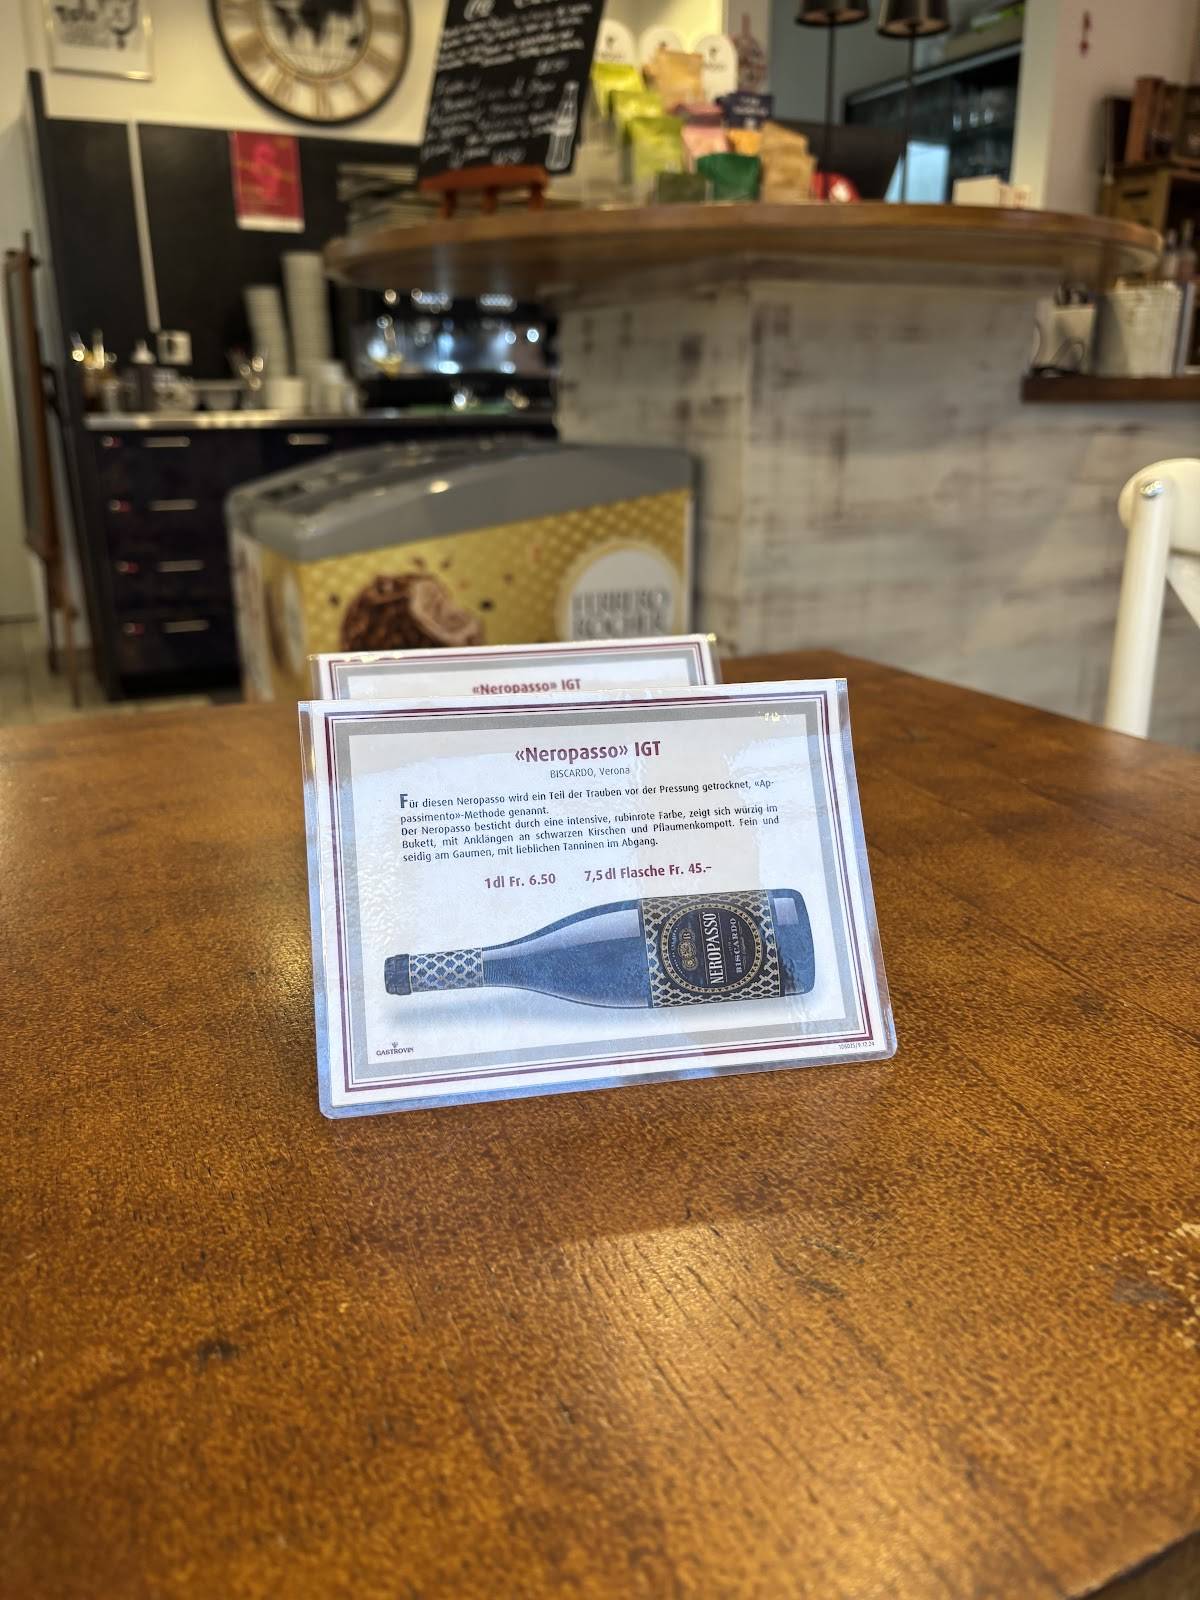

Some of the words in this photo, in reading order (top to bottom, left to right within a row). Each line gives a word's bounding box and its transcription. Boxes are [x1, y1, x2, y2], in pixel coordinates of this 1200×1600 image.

[561, 678, 582, 691] IGT
[514, 745, 628, 764] «Neropasso»
[634, 740, 661, 757] IGT
[550, 767, 596, 779] BISCARDO,
[599, 766, 630, 776] Verona
[399, 793, 419, 809] Für
[422, 797, 454, 808] diesen
[456, 795, 505, 807] Neropasso
[508, 792, 529, 803] wird
[532, 792, 546, 801] ein
[549, 790, 565, 800] Teil
[568, 789, 582, 799] der
[586, 787, 622, 798] Trauben
[625, 787, 639, 796] vor
[642, 785, 656, 795] der
[659, 783, 699, 796] Pressung
[702, 779, 752, 793] getrocknet,
[401, 826, 417, 836] Der
[421, 823, 471, 836] Neropasso
[474, 820, 511, 832] besticht
[515, 818, 540, 829] durch
[544, 817, 564, 827] eine
[567, 814, 613, 826] intensive,
[614, 812, 655, 823] rubinrote
[658, 809, 685, 820] Farbe,
[689, 808, 710, 820] zeigt
[714, 806, 731, 817] sich
[734, 804, 763, 817] würzig
[766, 804, 778, 813] im
[508, 806, 549, 819] genannt.
[402, 838, 437, 850] Bukett,
[442, 836, 458, 846] mit
[463, 833, 514, 846] Anklängen
[518, 833, 530, 842] an
[535, 830, 583, 841] schwarzen
[588, 825, 626, 836] Kirschen
[631, 824, 648, 834] und
[653, 819, 735, 834] Pflaumenkompott.
[739, 817, 758, 827] Fein
[762, 815, 780, 826] und
[402, 851, 432, 863] seidig
[434, 852, 450, 861] am
[452, 848, 494, 860] Gaumen,
[497, 845, 513, 856] mit
[516, 843, 560, 854] lieblichen
[563, 840, 604, 851] Tanninen
[607, 839, 619, 849] im
[622, 837, 659, 850] Abgang.
[509, 875, 525, 888] Fr.
[529, 872, 556, 886] 6.50
[620, 864, 666, 879] Flasche
[669, 863, 684, 876] Fr.
[702, 912, 725, 985] NEROPASSO
